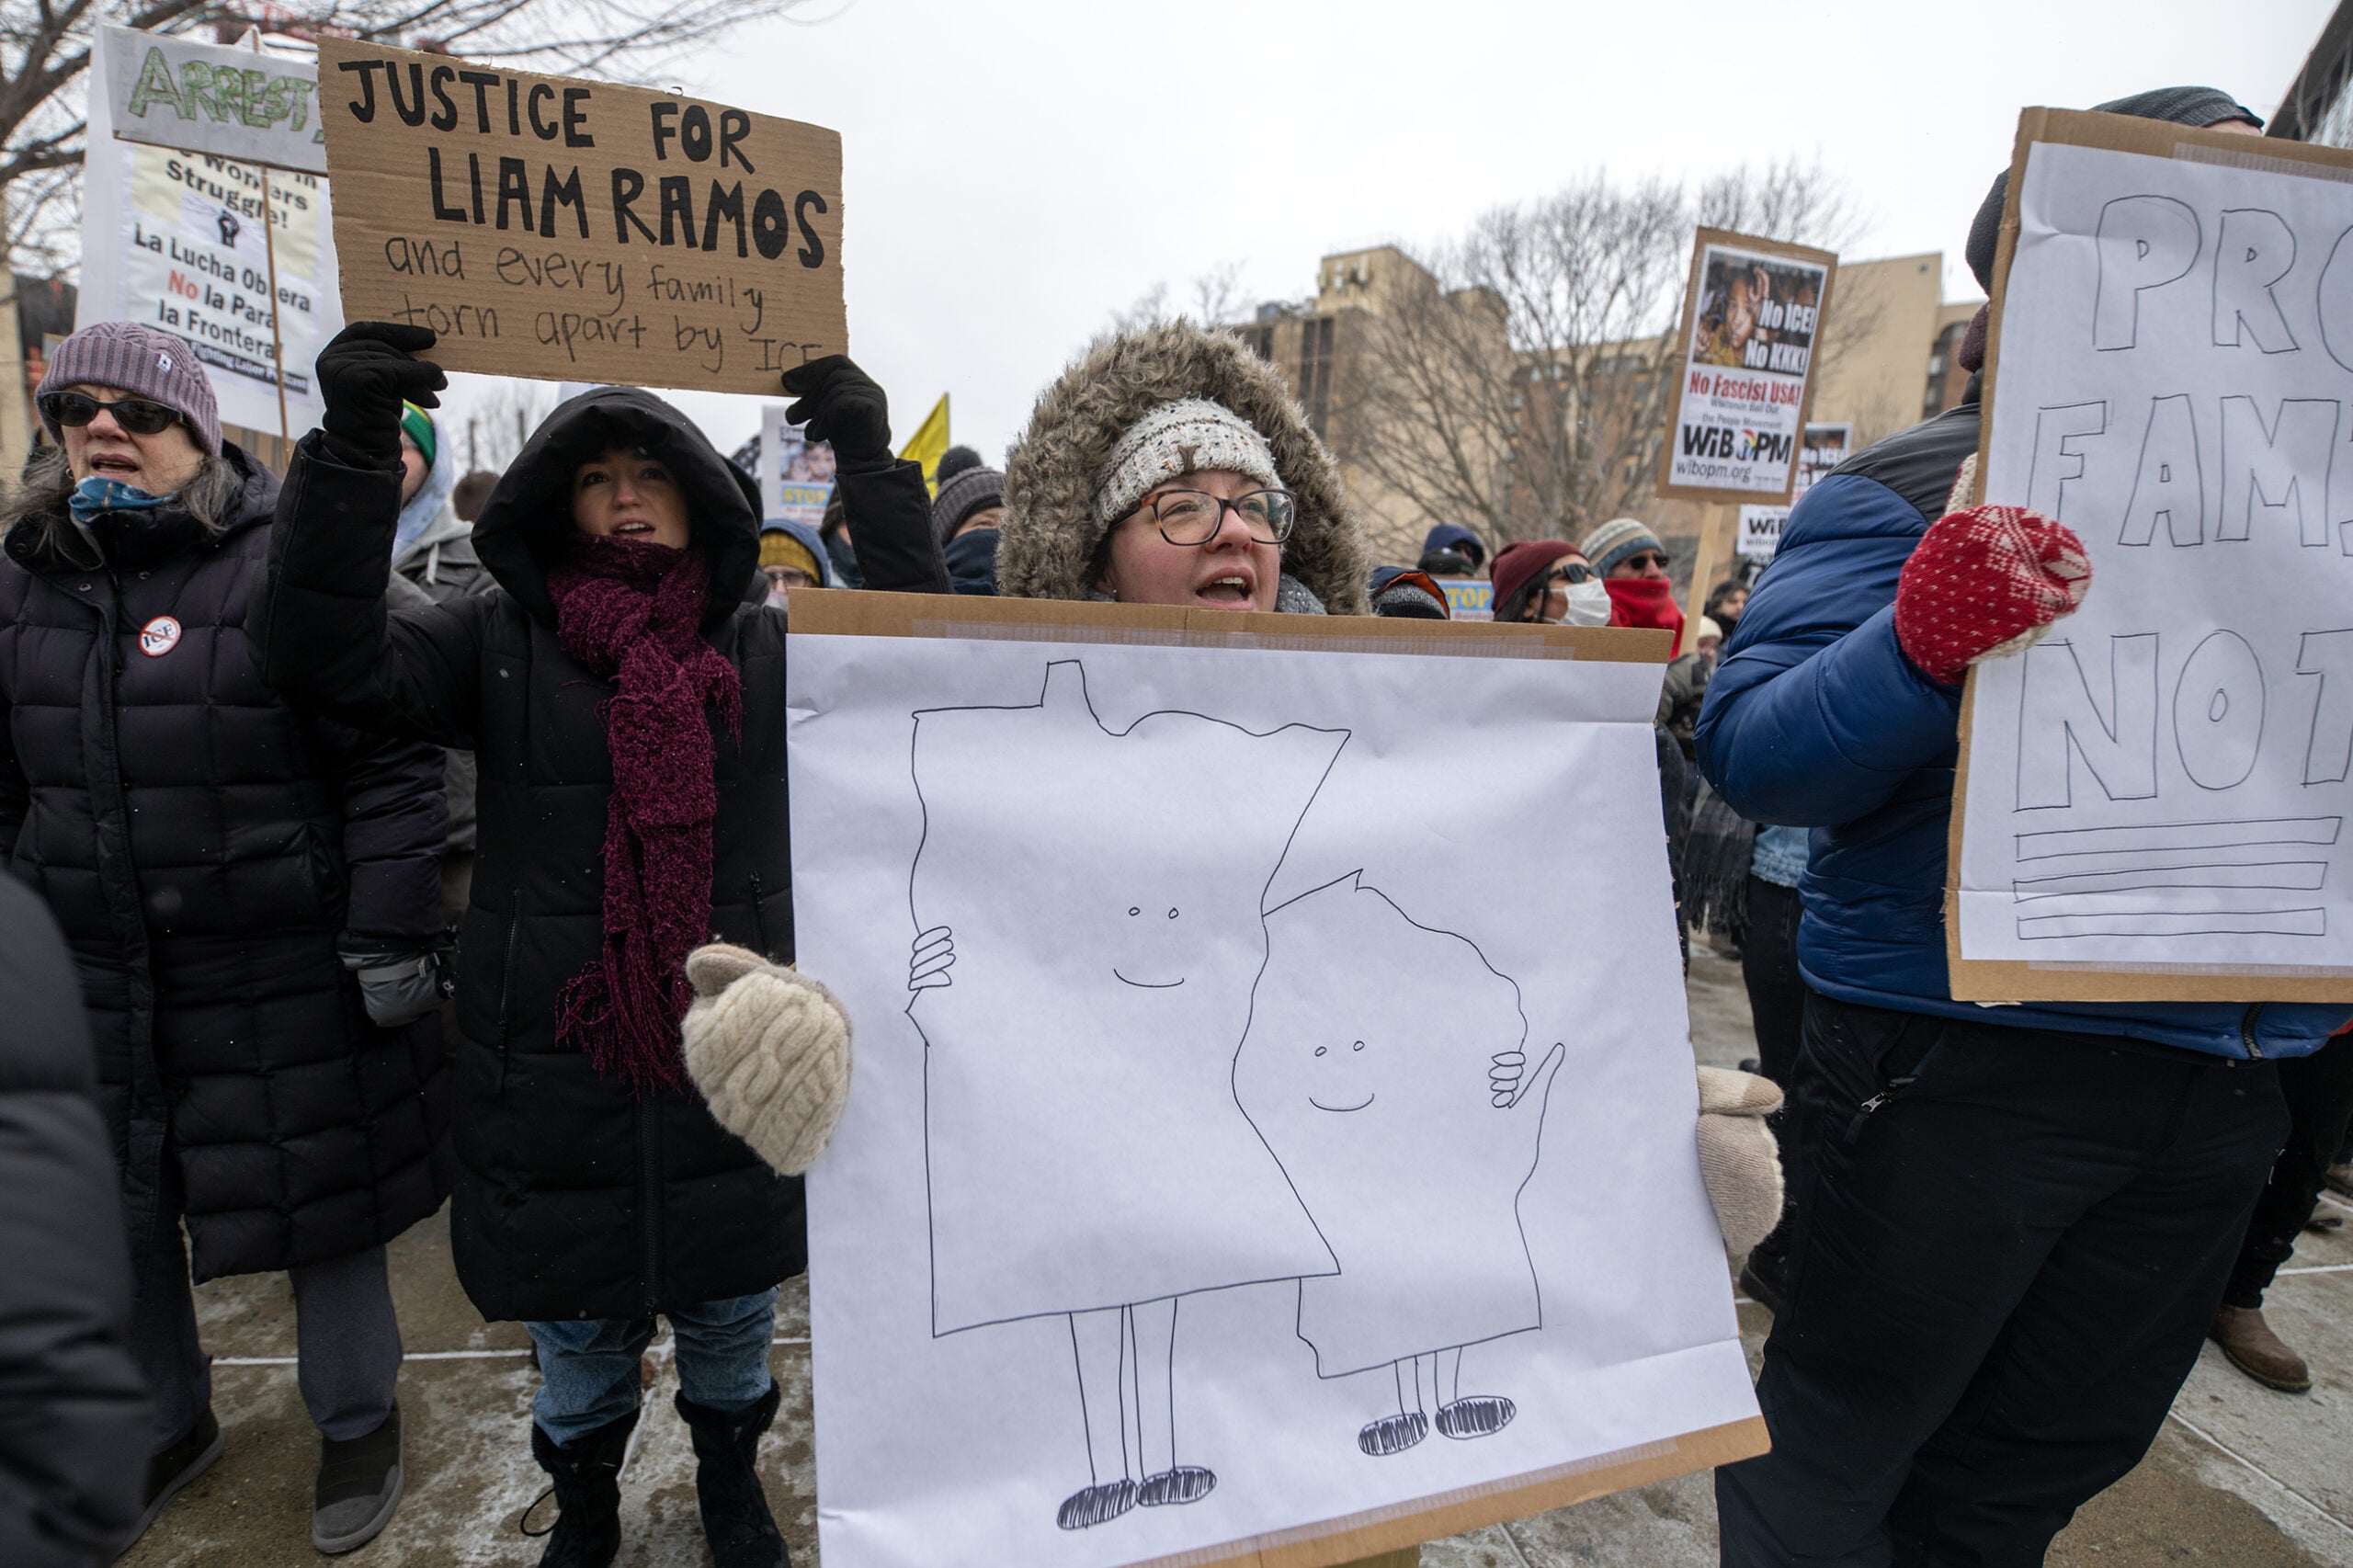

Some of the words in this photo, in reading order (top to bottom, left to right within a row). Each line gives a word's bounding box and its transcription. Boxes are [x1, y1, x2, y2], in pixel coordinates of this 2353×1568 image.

[129, 46, 316, 132] ARREST
[338, 59, 596, 148] JUSTICE
[650, 100, 756, 175] FOR
[166, 159, 288, 229] Struggle!
[427, 146, 590, 240] LIAM
[610, 167, 828, 269] RAMOS
[134, 222, 163, 254] La
[169, 237, 235, 283] Lucha
[242, 267, 311, 313] Obera
[167, 269, 199, 301] No
[204, 284, 224, 311] la
[384, 236, 465, 280] and
[496, 246, 625, 316] every
[646, 264, 763, 335] family
[158, 299, 179, 326] la
[186, 310, 282, 359] Frontera
[392, 293, 499, 338] torn
[535, 311, 647, 362] apart
[674, 313, 723, 373] by
[1758, 299, 1784, 330] No
[1783, 302, 1817, 334] ICE!
[1689, 371, 1710, 395] No
[1712, 374, 1768, 402] Fascist
[1769, 381, 1802, 406] USA!
[1744, 338, 1769, 368] No
[1768, 341, 1808, 374] KKK!
[782, 487, 827, 504] STOP
[1677, 460, 1753, 483] wibopm.org
[2027, 392, 2353, 557] FAM
[1444, 587, 1492, 608] TOP
